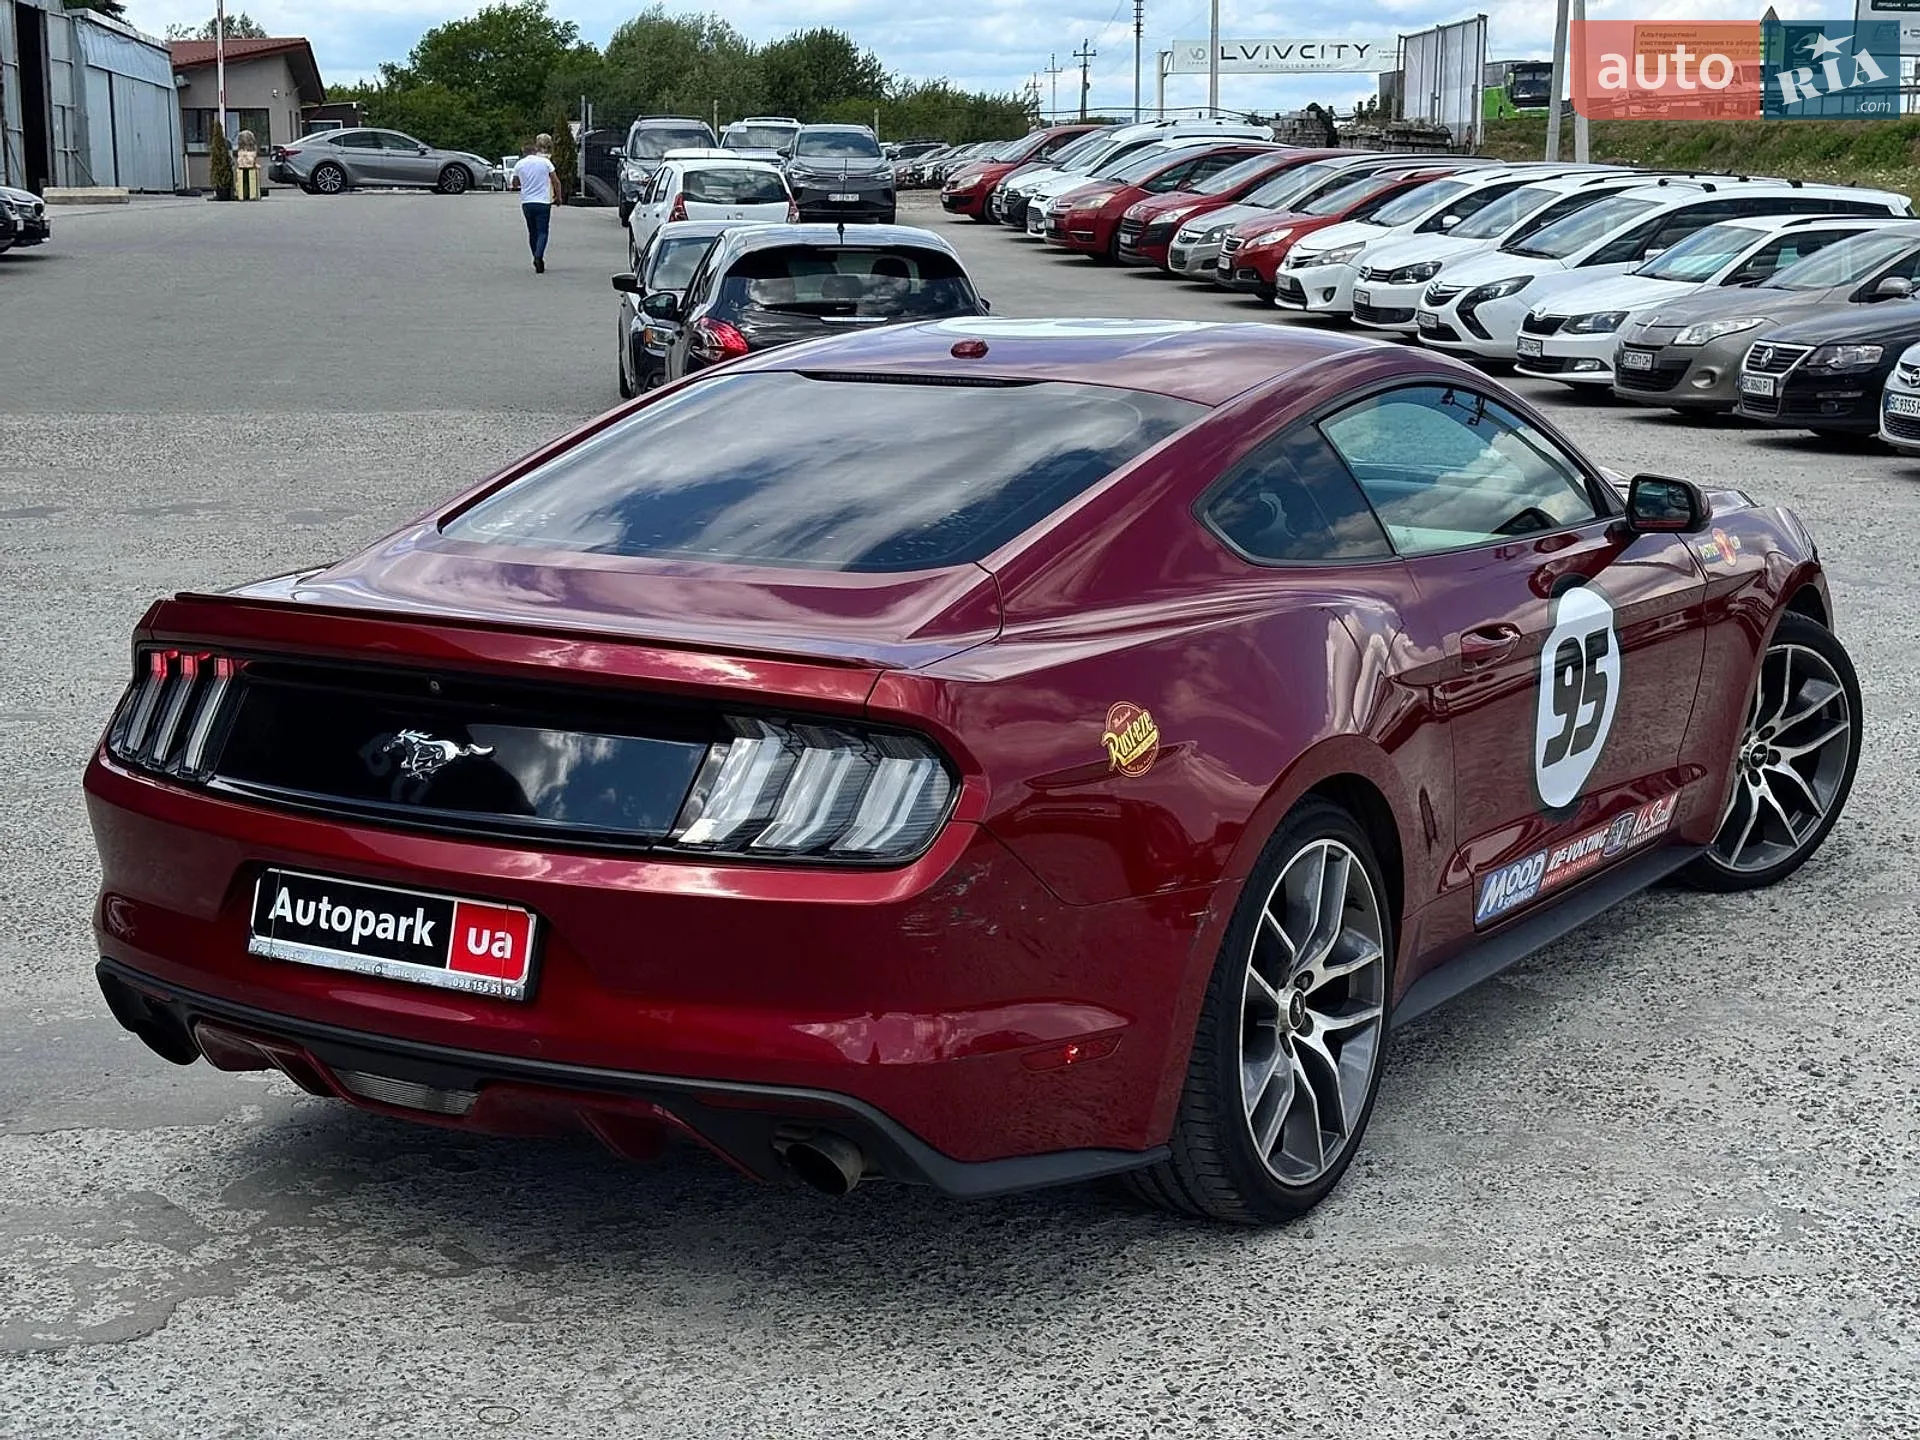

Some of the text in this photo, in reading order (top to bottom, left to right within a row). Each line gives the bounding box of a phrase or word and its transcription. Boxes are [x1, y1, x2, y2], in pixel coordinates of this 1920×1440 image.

[1220, 44, 1371, 60] LVIVCITY
[1541, 627, 1609, 769] 95
[1477, 853, 1546, 918] MOOD
[268, 886, 513, 960] Autopark ua
